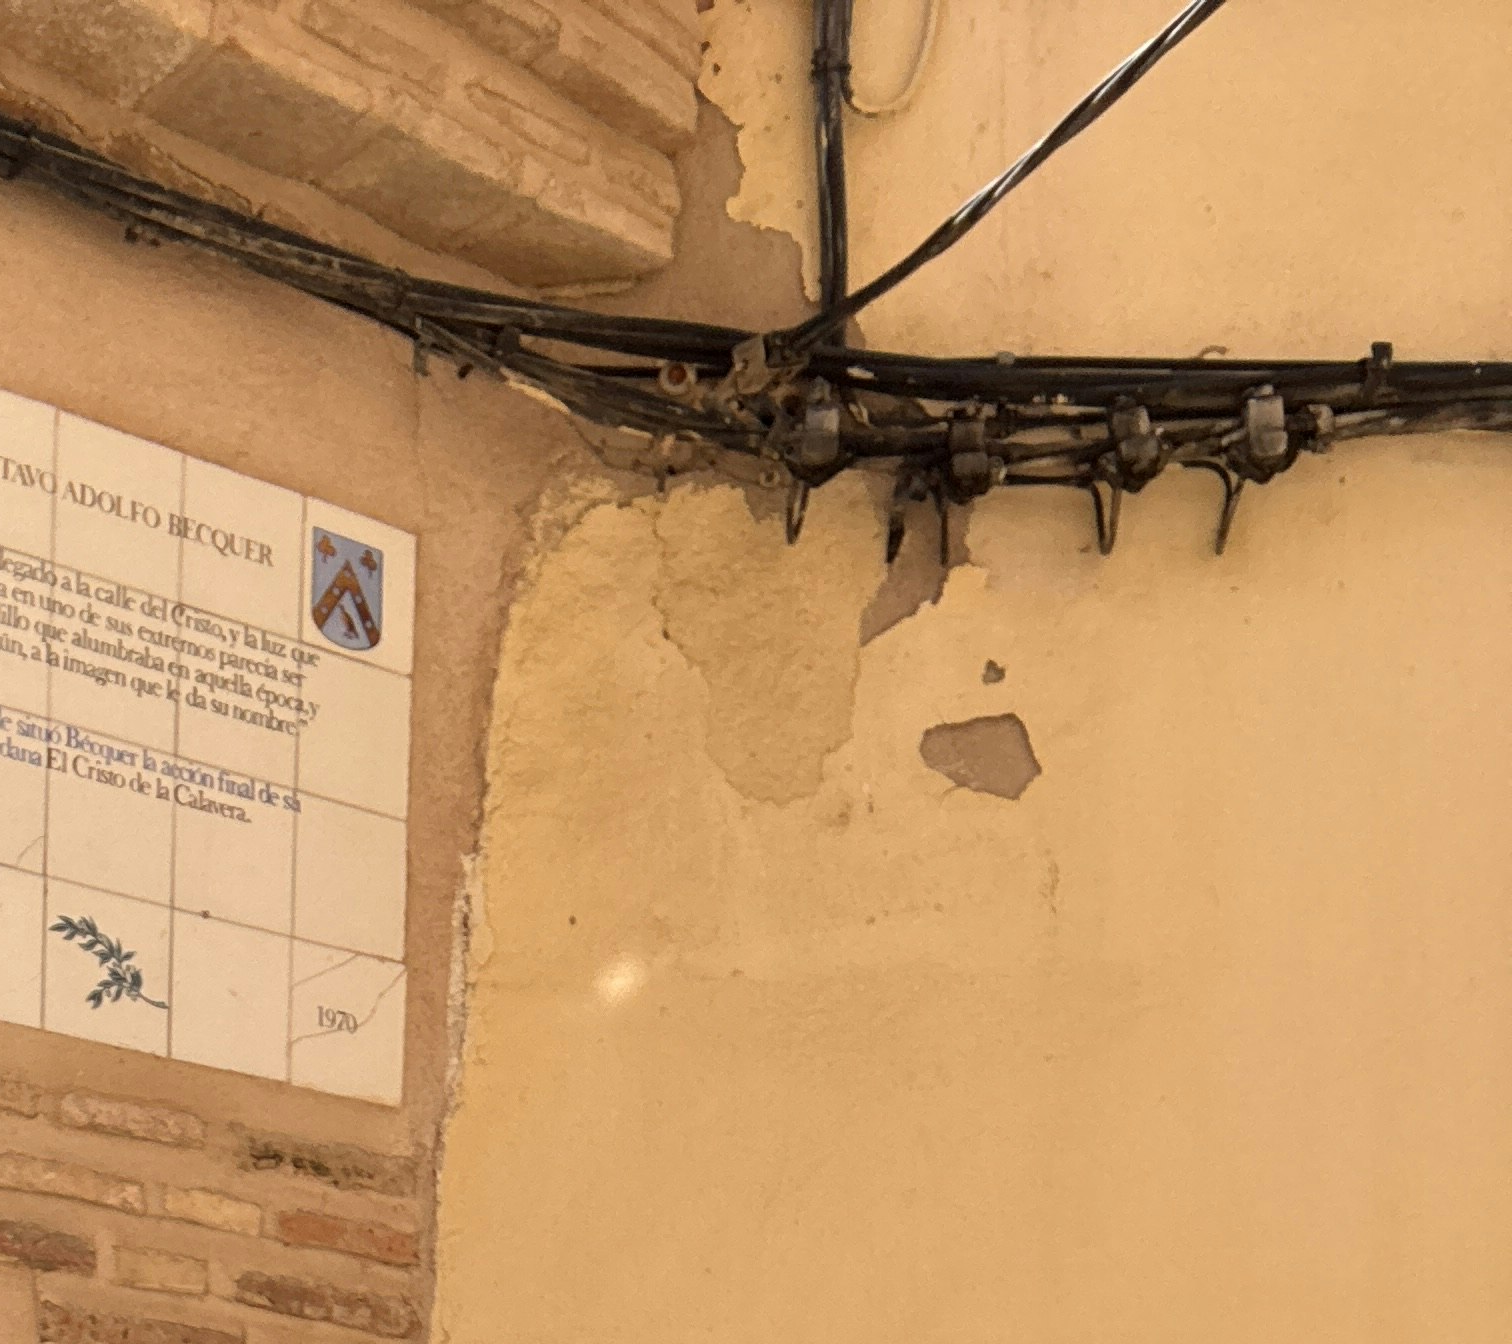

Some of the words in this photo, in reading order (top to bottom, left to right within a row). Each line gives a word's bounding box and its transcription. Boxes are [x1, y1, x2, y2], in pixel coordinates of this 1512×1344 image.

[62, 480, 161, 528] ADOLFO
[168, 512, 274, 567] BECQUER
[12, 586, 36, 607] en
[39, 594, 76, 619] uno
[79, 602, 101, 627] de
[105, 616, 133, 636] sus
[137, 626, 216, 662] extremos
[281, 669, 307, 688] ser
[61, 576, 72, 592] a
[76, 571, 92, 599] la
[95, 584, 136, 612] calle
[140, 594, 168, 622] del
[229, 628, 240, 648] y
[244, 624, 258, 650] la
[261, 631, 287, 659] luz
[291, 647, 321, 668] que
[30, 645, 42, 662] a
[45, 642, 60, 668] la
[63, 648, 127, 687] imagen
[130, 676, 163, 698] que
[167, 679, 182, 703] le
[186, 686, 207, 710] da
[210, 699, 230, 717] su
[34, 620, 68, 643] que
[71, 627, 165, 673] alumbraba
[168, 661, 191, 681] en
[194, 668, 254, 699] aquella
[46, 747, 67, 774] El
[72, 754, 128, 789] Cristo
[129, 771, 153, 796] de
[155, 777, 171, 802] la
[174, 783, 253, 824] Calavera.
[66, 726, 138, 767] Bécquer
[143, 749, 157, 773] la
[218, 769, 256, 801] final
[258, 783, 281, 806] de
[317, 1005, 359, 1035] 1970
